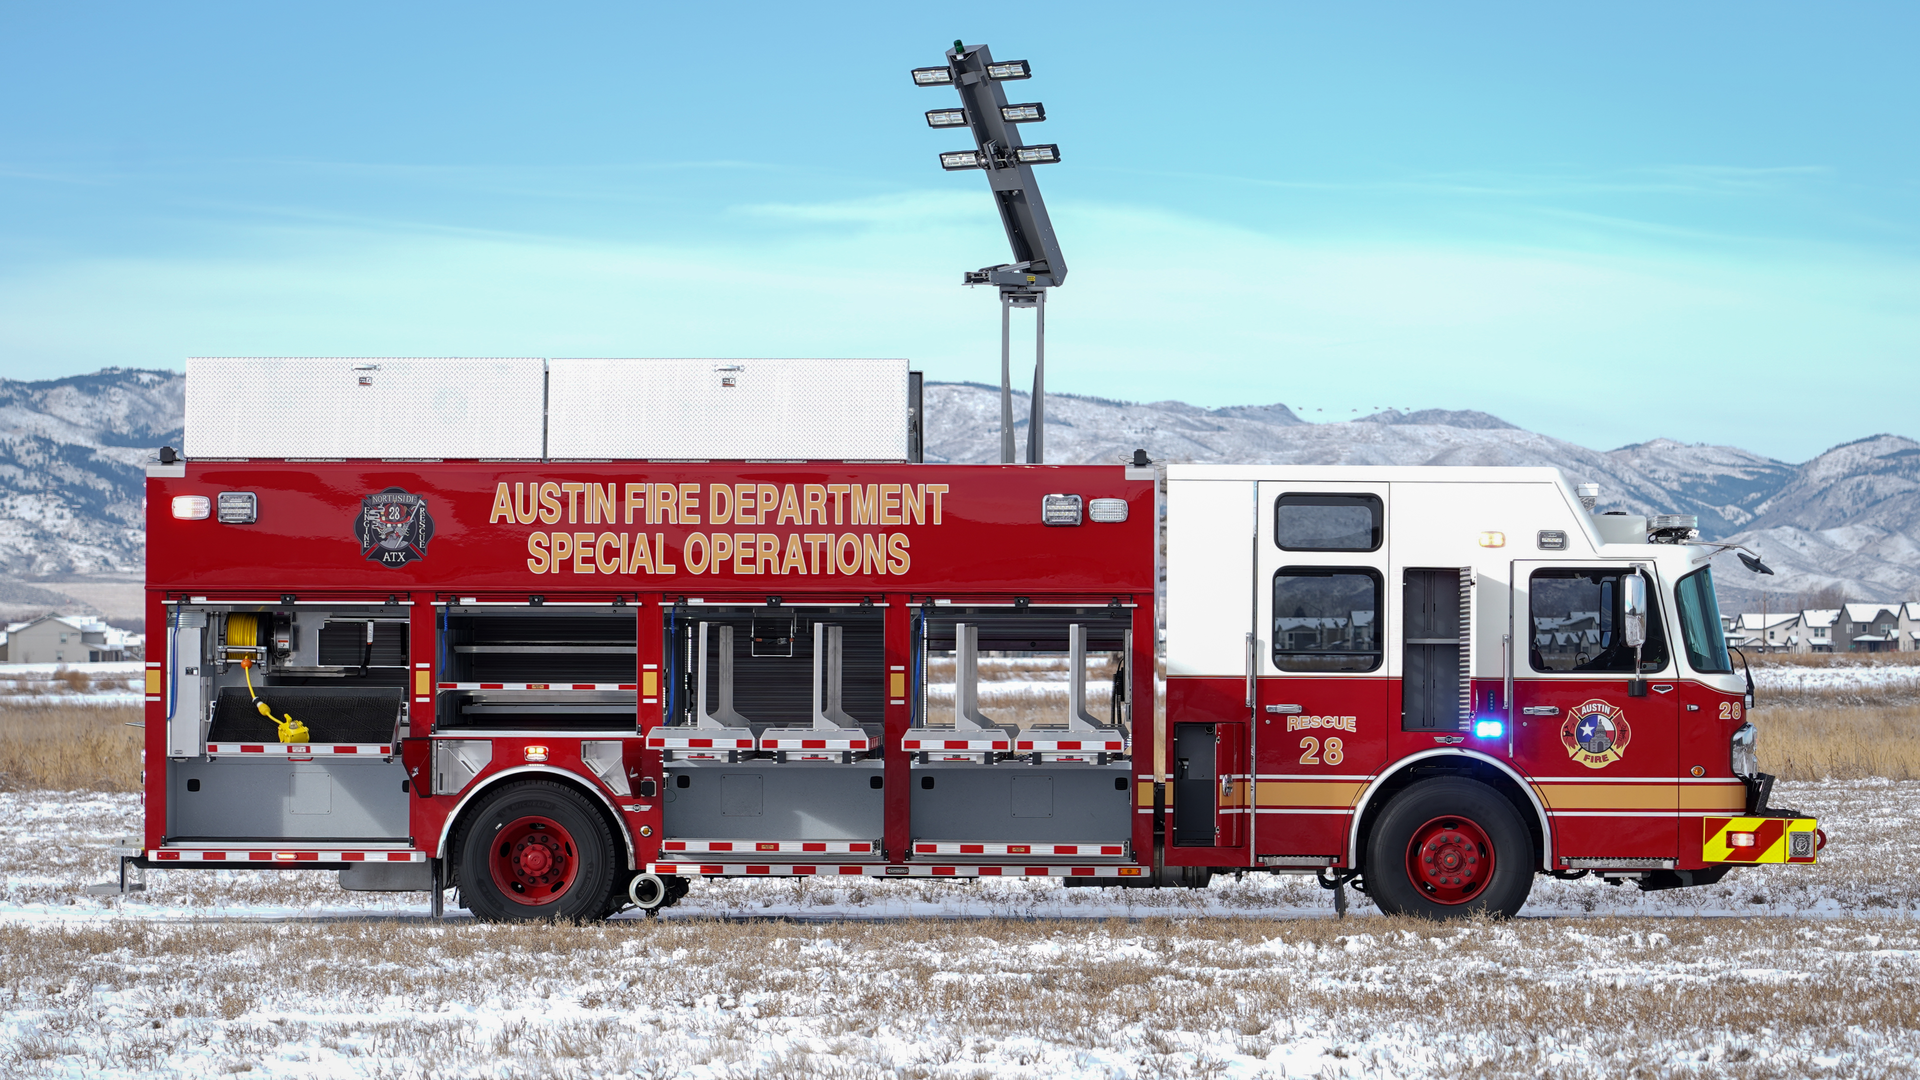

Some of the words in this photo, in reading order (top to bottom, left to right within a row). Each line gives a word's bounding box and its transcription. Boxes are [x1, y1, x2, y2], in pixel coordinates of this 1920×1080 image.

[372, 494, 417, 503] NORTHSIDE
[489, 482, 616, 525] AUSTIN
[625, 482, 701, 525] FIRE
[709, 483, 949, 526] DEPARTMENT
[388, 506, 400, 520] 28
[382, 552, 406, 562] ATX
[527, 531, 677, 575] SPECIAL
[683, 532, 911, 576] OPERATIONS
[1581, 703, 1611, 715] AUSTIN
[1718, 701, 1742, 720] 28
[1286, 715, 1357, 733] RESCUE
[1299, 736, 1344, 766] 28
[1582, 754, 1610, 764] FIRE
[511, 801, 552, 811] MICHELIN
